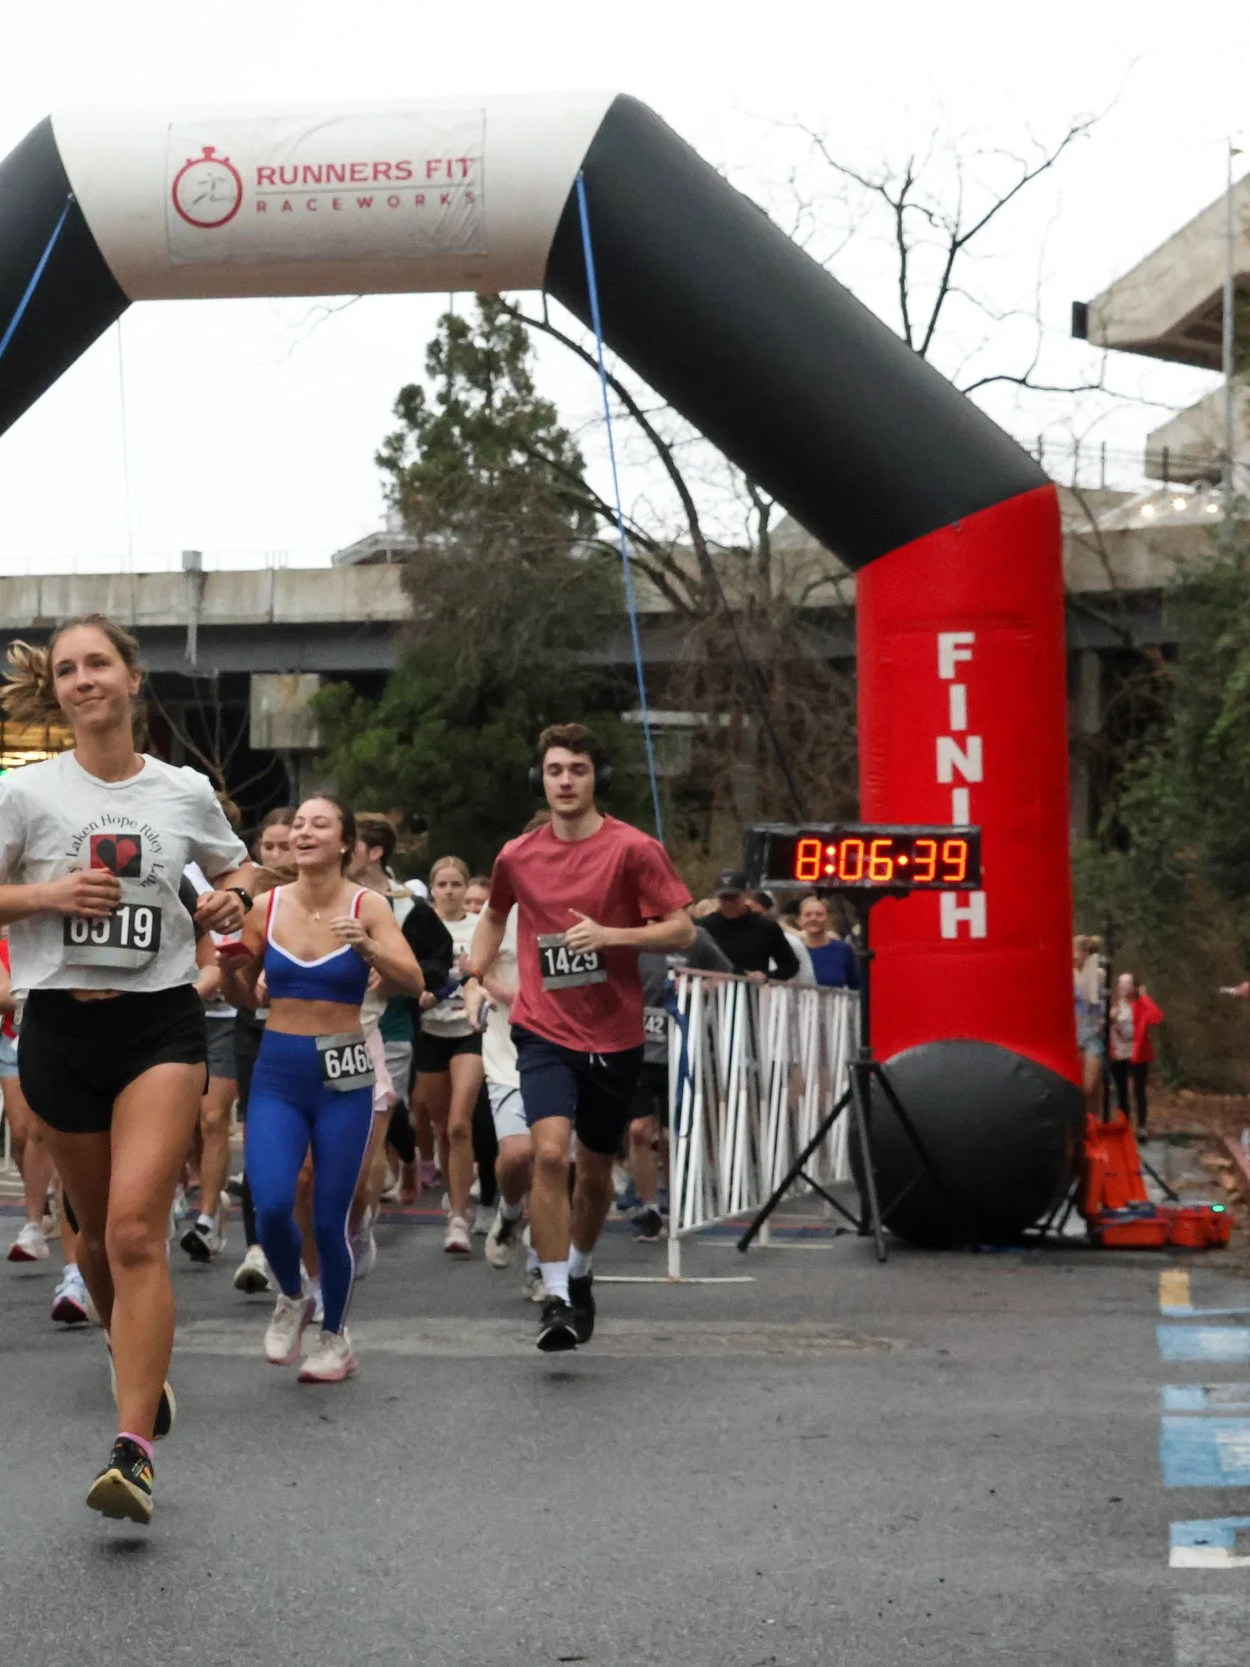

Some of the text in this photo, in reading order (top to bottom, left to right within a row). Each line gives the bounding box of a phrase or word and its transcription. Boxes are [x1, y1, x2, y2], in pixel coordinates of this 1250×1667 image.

[256, 157, 472, 186] RUNNERS FIT
[255, 190, 477, 214] RACEWORKS
[936, 631, 987, 939] FINIH
[65, 813, 163, 857] Laken Hope Riley
[544, 947, 599, 976] 1429
